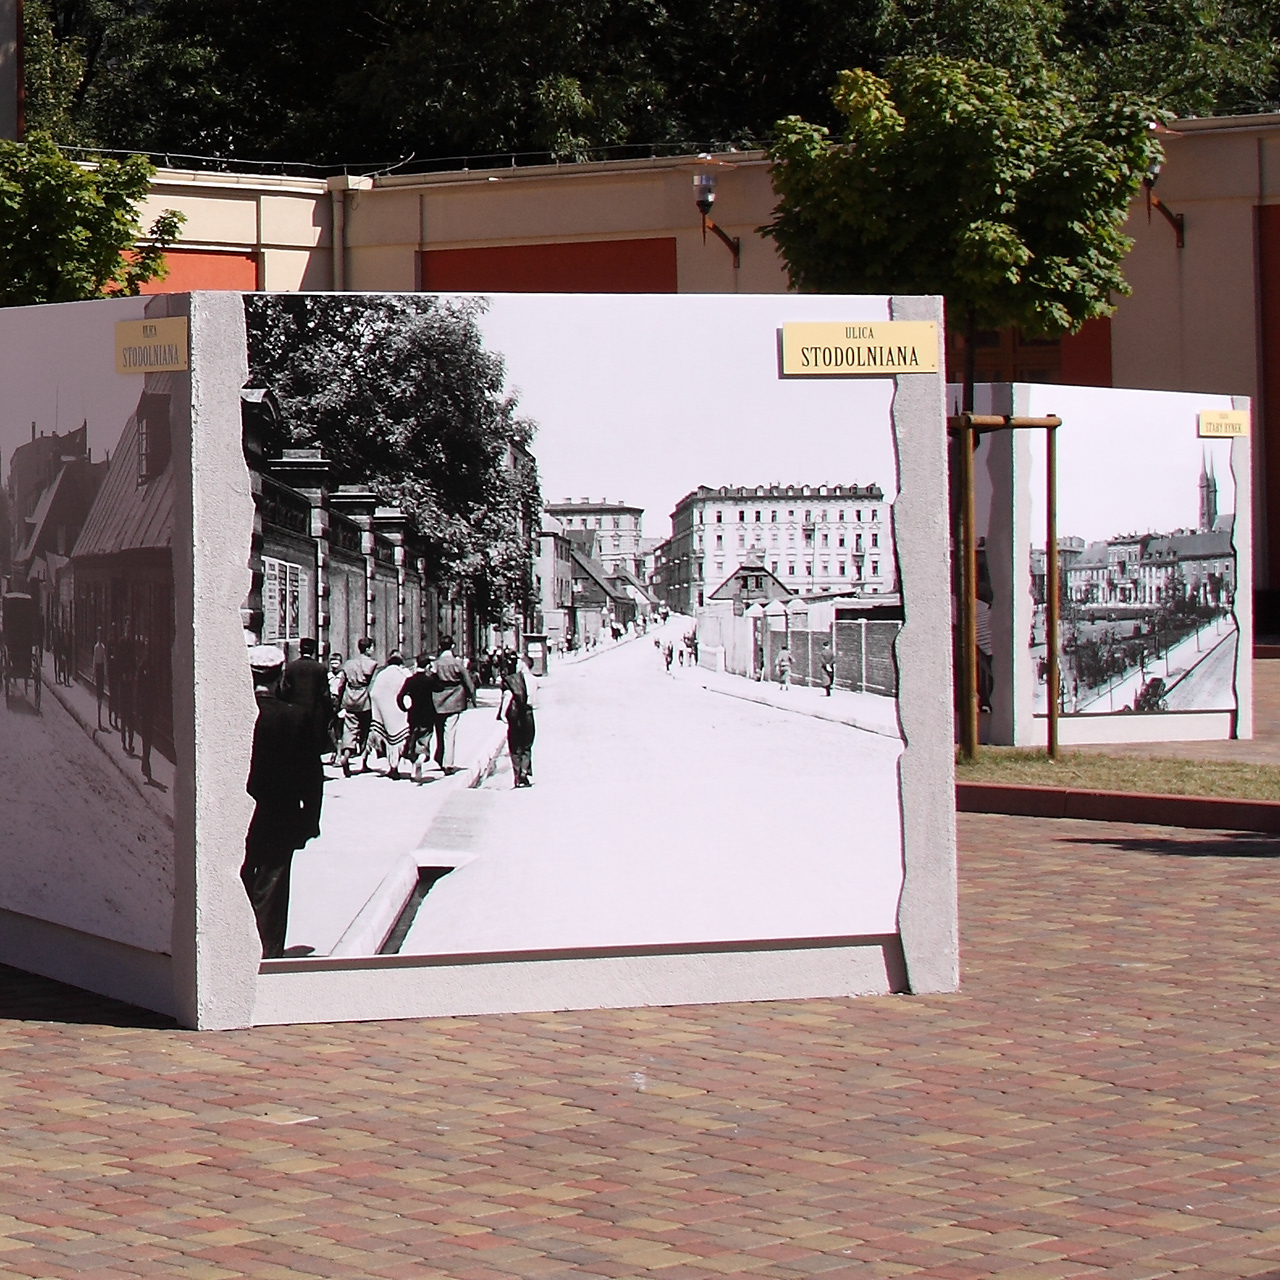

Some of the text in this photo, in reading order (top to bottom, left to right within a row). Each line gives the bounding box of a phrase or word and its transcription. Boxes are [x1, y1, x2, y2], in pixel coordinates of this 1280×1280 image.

[845, 326, 874, 339] ULICA
[122, 344, 179, 368] STODOLNIANA
[800, 346, 920, 367] STODOLNIANA
